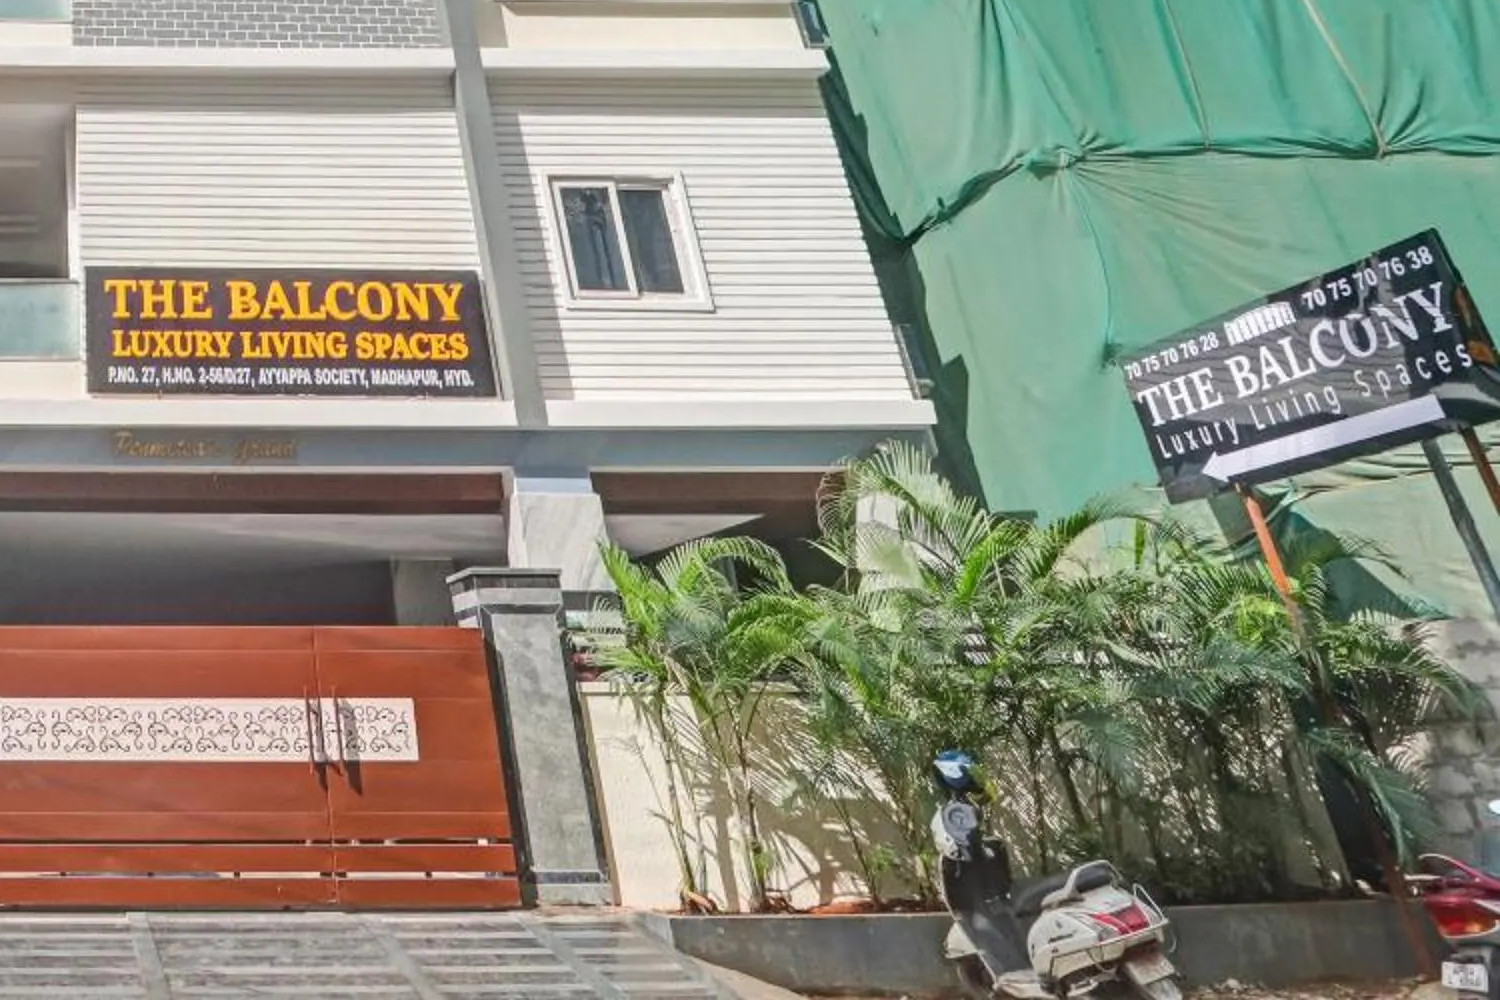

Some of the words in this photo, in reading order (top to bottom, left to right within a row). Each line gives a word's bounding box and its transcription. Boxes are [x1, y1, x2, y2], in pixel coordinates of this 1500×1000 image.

[103, 279, 213, 320] THE
[227, 280, 464, 322] BALCONY
[1301, 288, 1327, 311] 70
[1327, 279, 1352, 301] 75
[1353, 268, 1377, 291] 70
[1379, 256, 1406, 281] 76
[1406, 245, 1434, 271] 38
[112, 330, 234, 358] LUXURY
[240, 331, 348, 360] LIVING
[356, 332, 470, 361] SPACES
[1124, 361, 1142, 380] 70
[1142, 355, 1161, 374] 75
[1160, 347, 1179, 367] 70
[1179, 339, 1199, 359] 76
[1200, 332, 1219, 352] 28
[1136, 367, 1223, 427] THE
[1224, 281, 1454, 399] BALCONY
[258, 367, 313, 385] AYYAPPA
[314, 367, 369, 389] SOCIETY,
[371, 368, 443, 389] MADHAPUR,
[1156, 417, 1239, 459] Luxury
[1249, 385, 1341, 432] Living
[1353, 343, 1473, 399] Spaces
